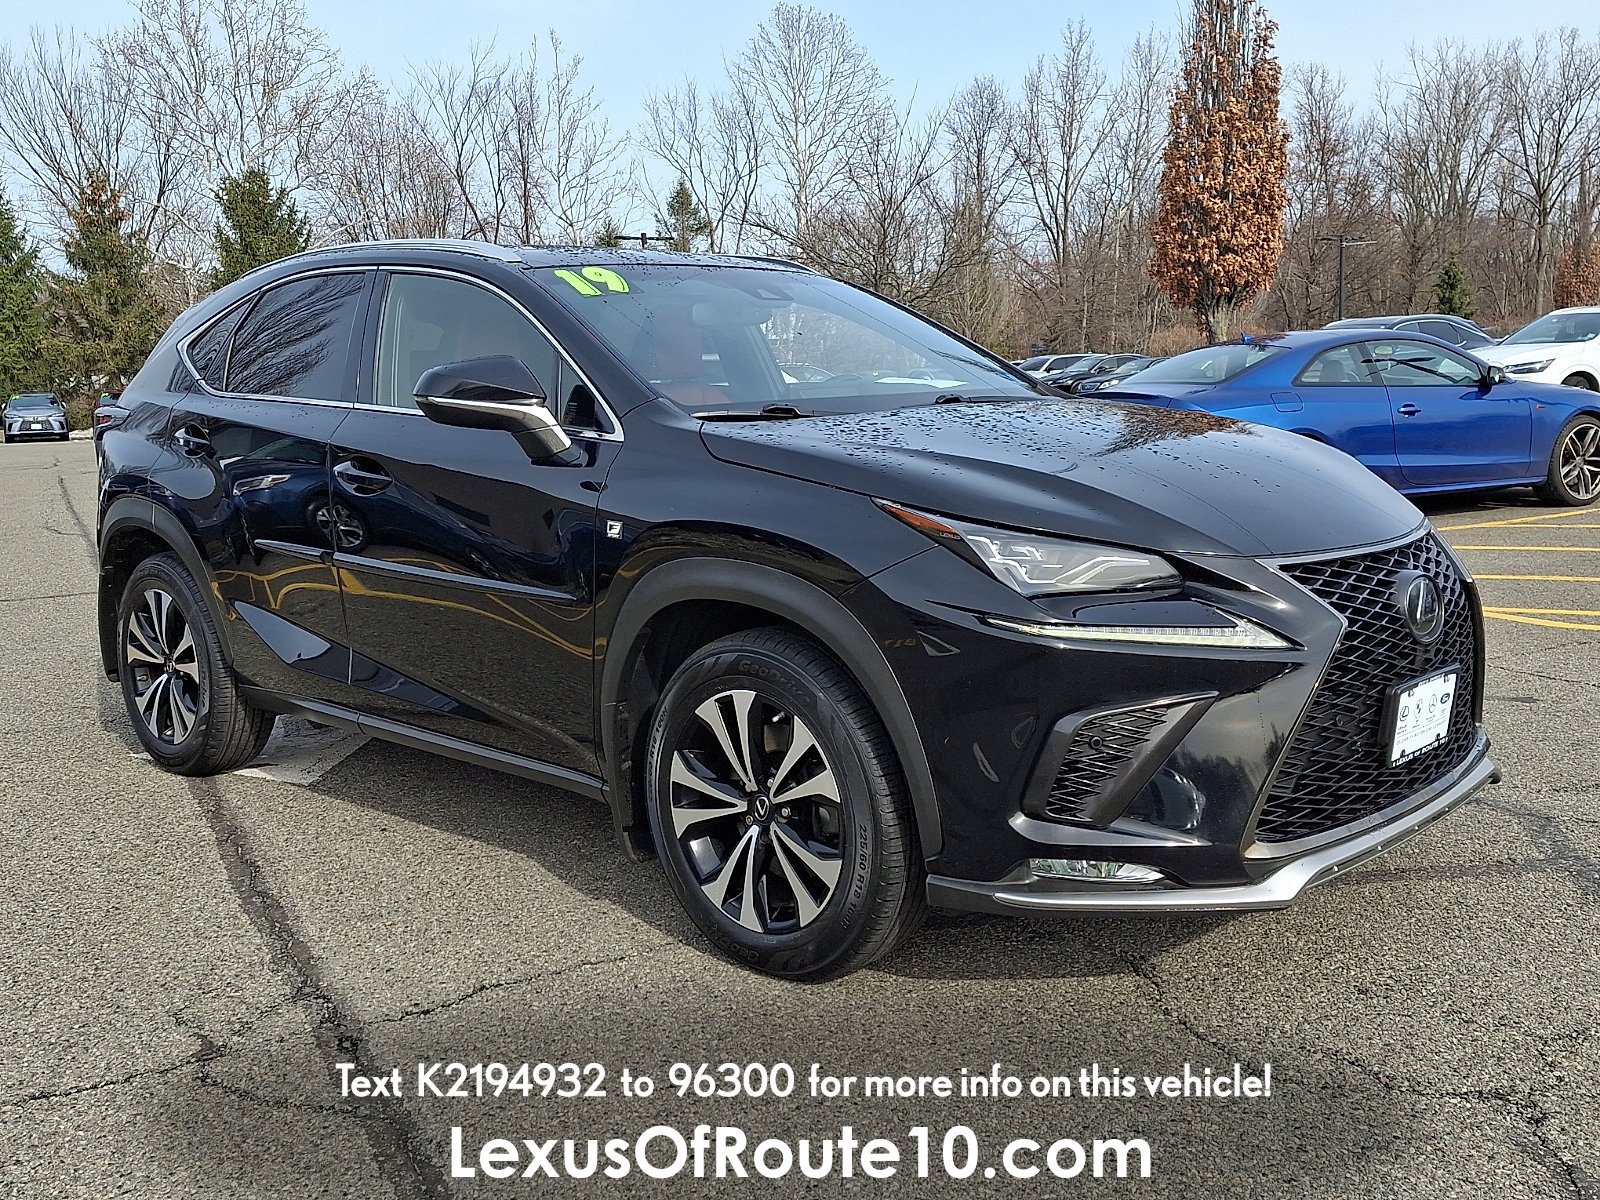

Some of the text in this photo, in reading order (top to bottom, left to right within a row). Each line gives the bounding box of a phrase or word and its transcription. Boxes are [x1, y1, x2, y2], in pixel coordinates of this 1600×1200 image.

[553, 266, 630, 298] 19
[1396, 753, 1414, 766] LEXUS
[1421, 740, 1439, 754] ROUTE
[858, 824, 868, 871] 225/60
[853, 874, 866, 899] R18
